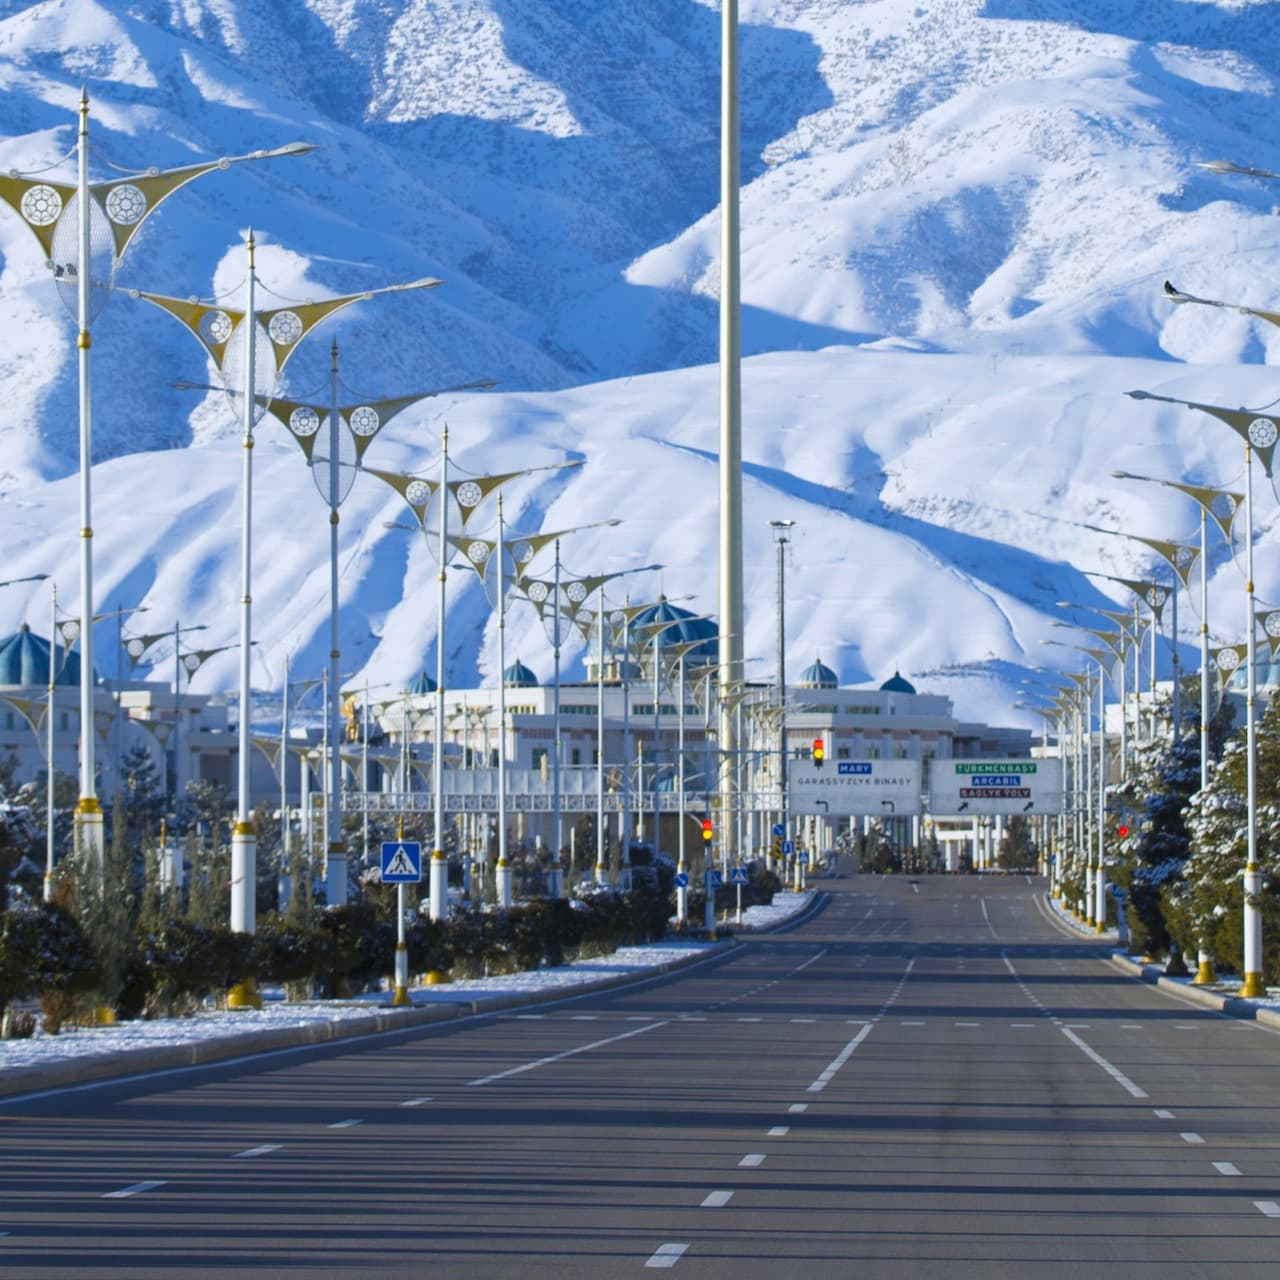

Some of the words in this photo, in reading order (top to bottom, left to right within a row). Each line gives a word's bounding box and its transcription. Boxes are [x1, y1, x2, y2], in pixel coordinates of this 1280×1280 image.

[839, 764, 870, 772] MARY
[874, 777, 911, 785] BINASY
[974, 777, 1019, 785] ARÇABIL
